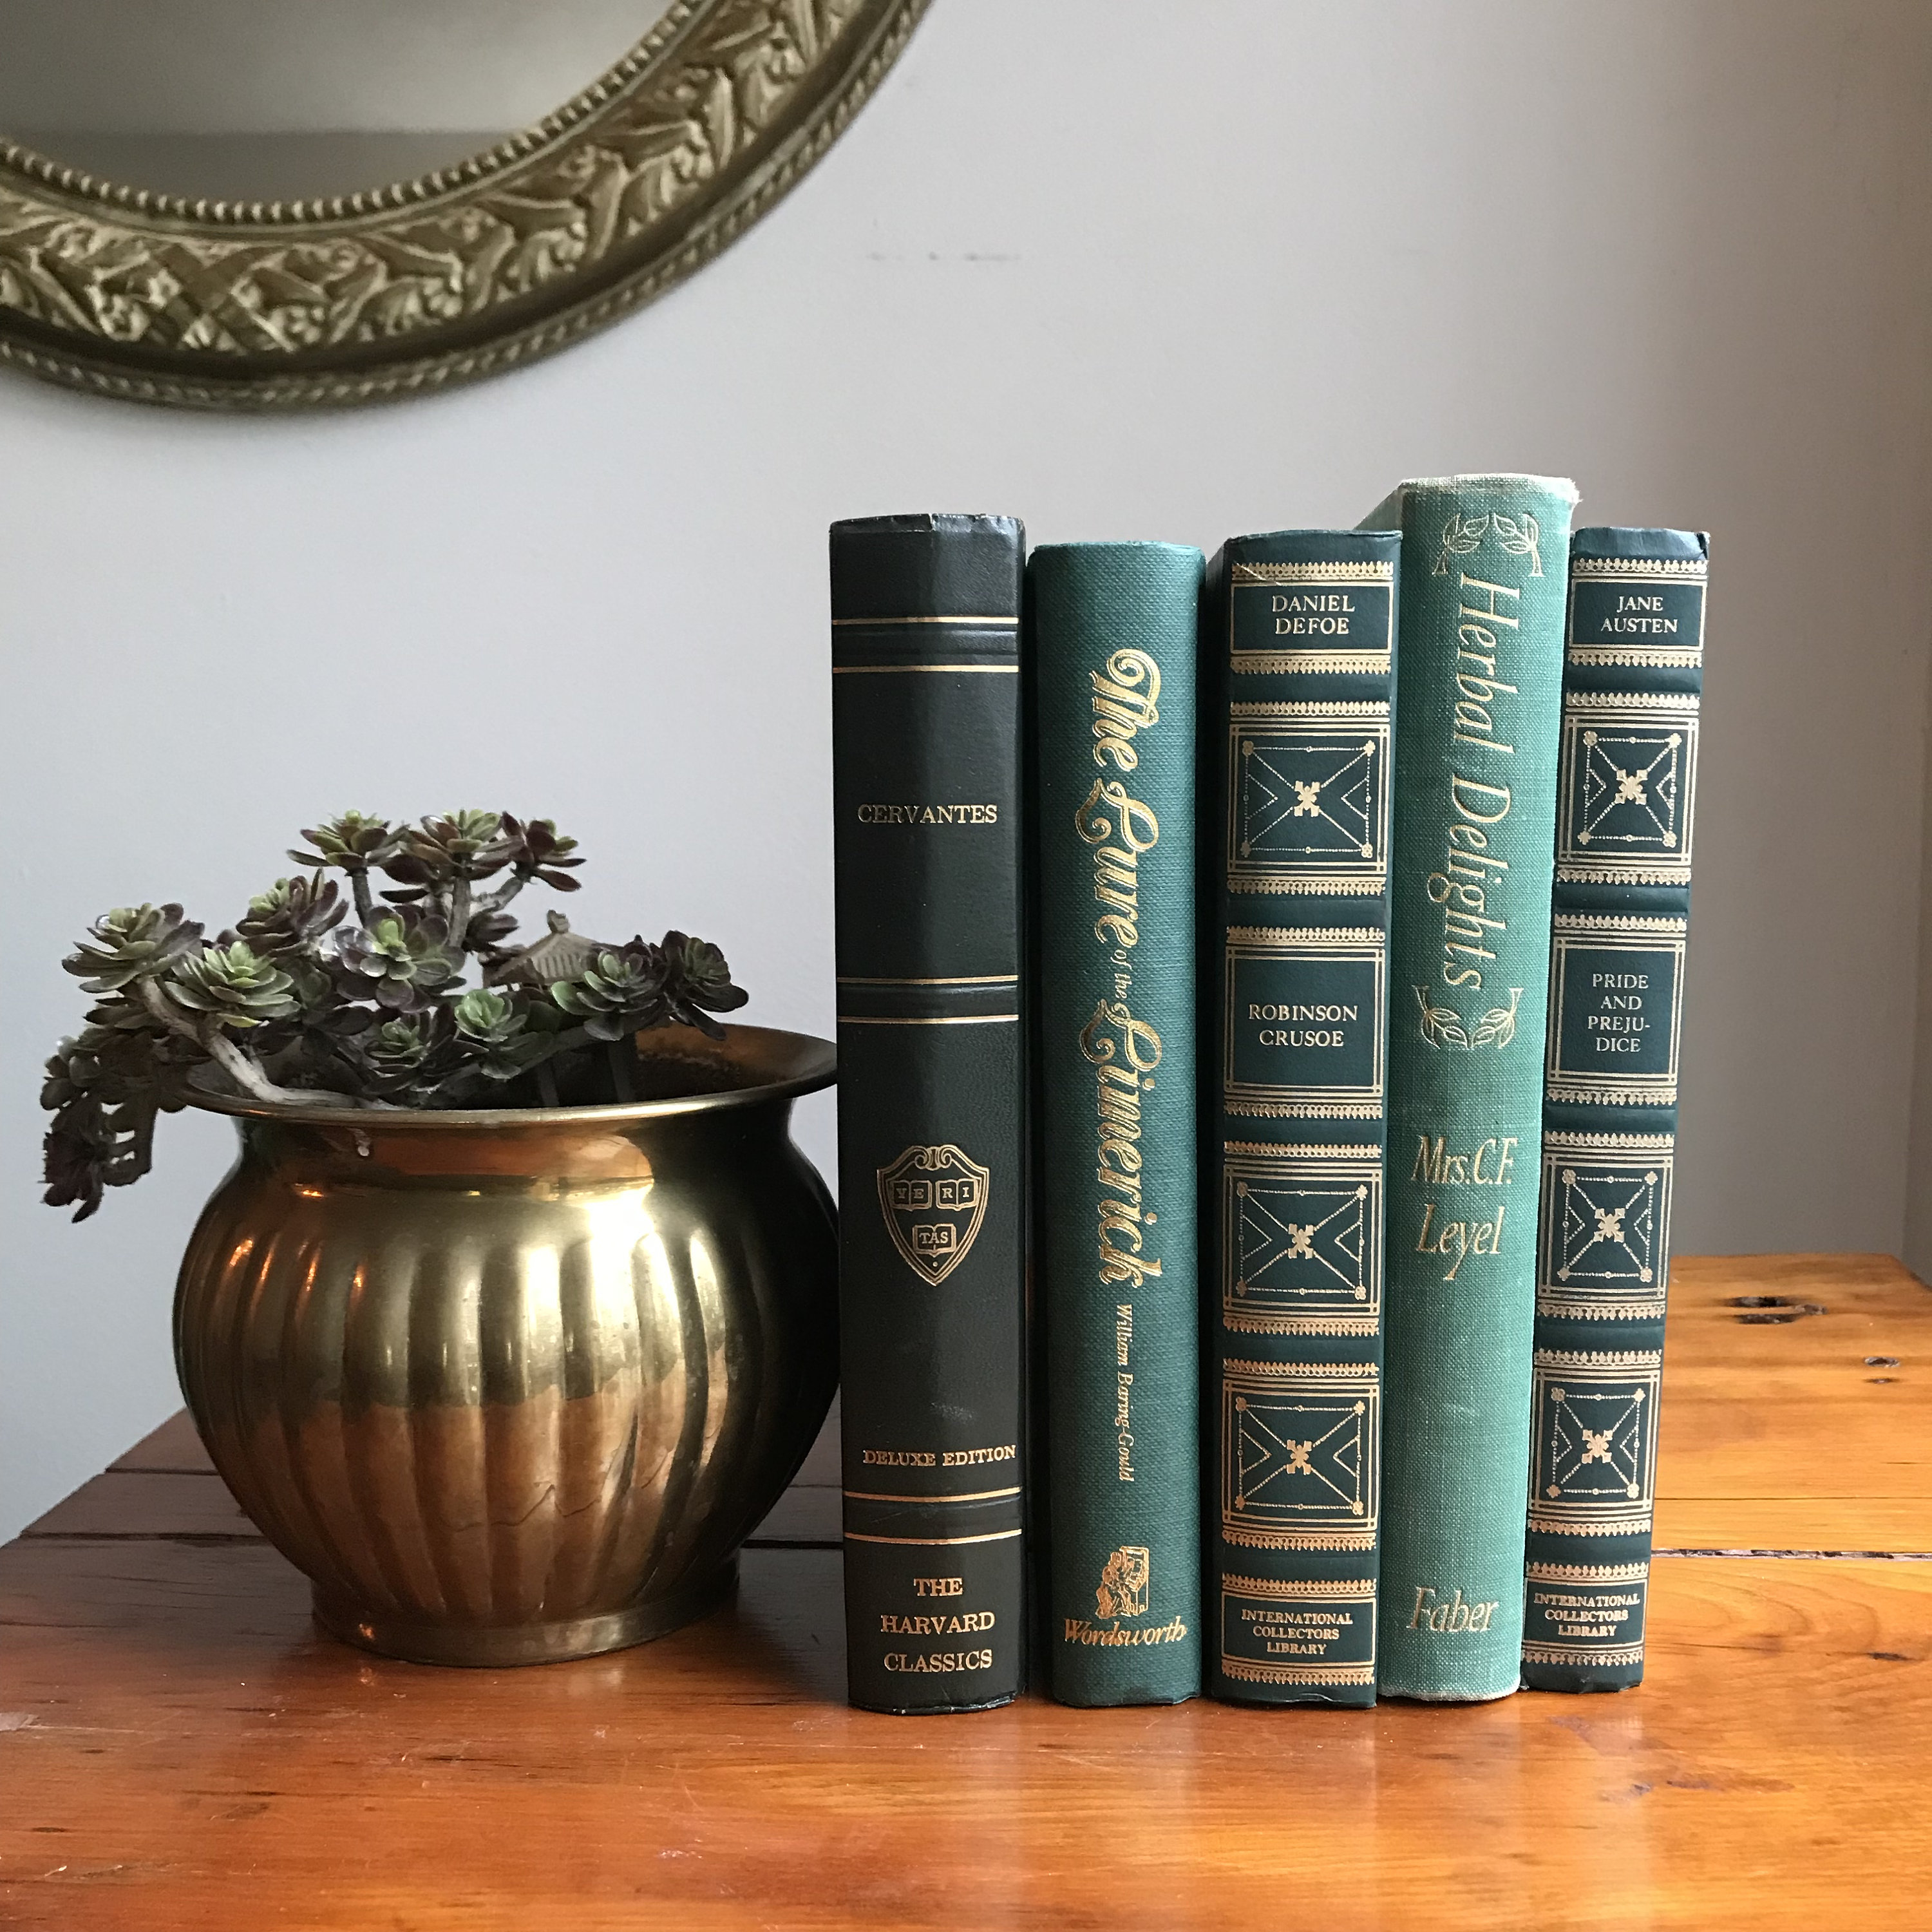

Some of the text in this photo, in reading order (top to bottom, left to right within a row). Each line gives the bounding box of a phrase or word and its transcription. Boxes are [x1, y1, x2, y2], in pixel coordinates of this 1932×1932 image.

[1272, 594, 1356, 612] DANIEL
[1616, 596, 1663, 613] JANE
[1275, 617, 1350, 634] DEFOE
[1601, 618, 1678, 633] AUSTEN
[1426, 572, 1520, 990] Herbal Delights
[857, 804, 998, 824] CERVANTES
[1075, 648, 1163, 1289] The Lure of the Limerick
[1592, 973, 1649, 989] PRIDE
[1248, 1003, 1358, 1021] ROBINSON
[1600, 996, 1642, 1010] AND
[1587, 1016, 1651, 1034] PREJU-
[1259, 1030, 1345, 1047] CRUSOE
[1595, 1037, 1642, 1052] DICE
[1416, 1203, 1506, 1281] Leyel
[1114, 1303, 1135, 1482] William Baring-Gould
[863, 1444, 1017, 1468] DELUXE EDITION
[913, 1577, 964, 1597] THE
[1533, 1593, 1641, 1607] INTERNATIONAL
[1241, 1609, 1354, 1625] INTERNATIONAL
[1406, 1586, 1500, 1633] Faber
[1544, 1609, 1629, 1622] COLLECTORS
[880, 1611, 997, 1636] HARVARD
[1064, 1616, 1187, 1647] Wordsworth
[1253, 1625, 1340, 1640] COLLECTORS
[1557, 1624, 1618, 1638] LIBRARY
[1266, 1642, 1328, 1655] LIBRARY
[883, 1648, 994, 1674] CLASSICS
